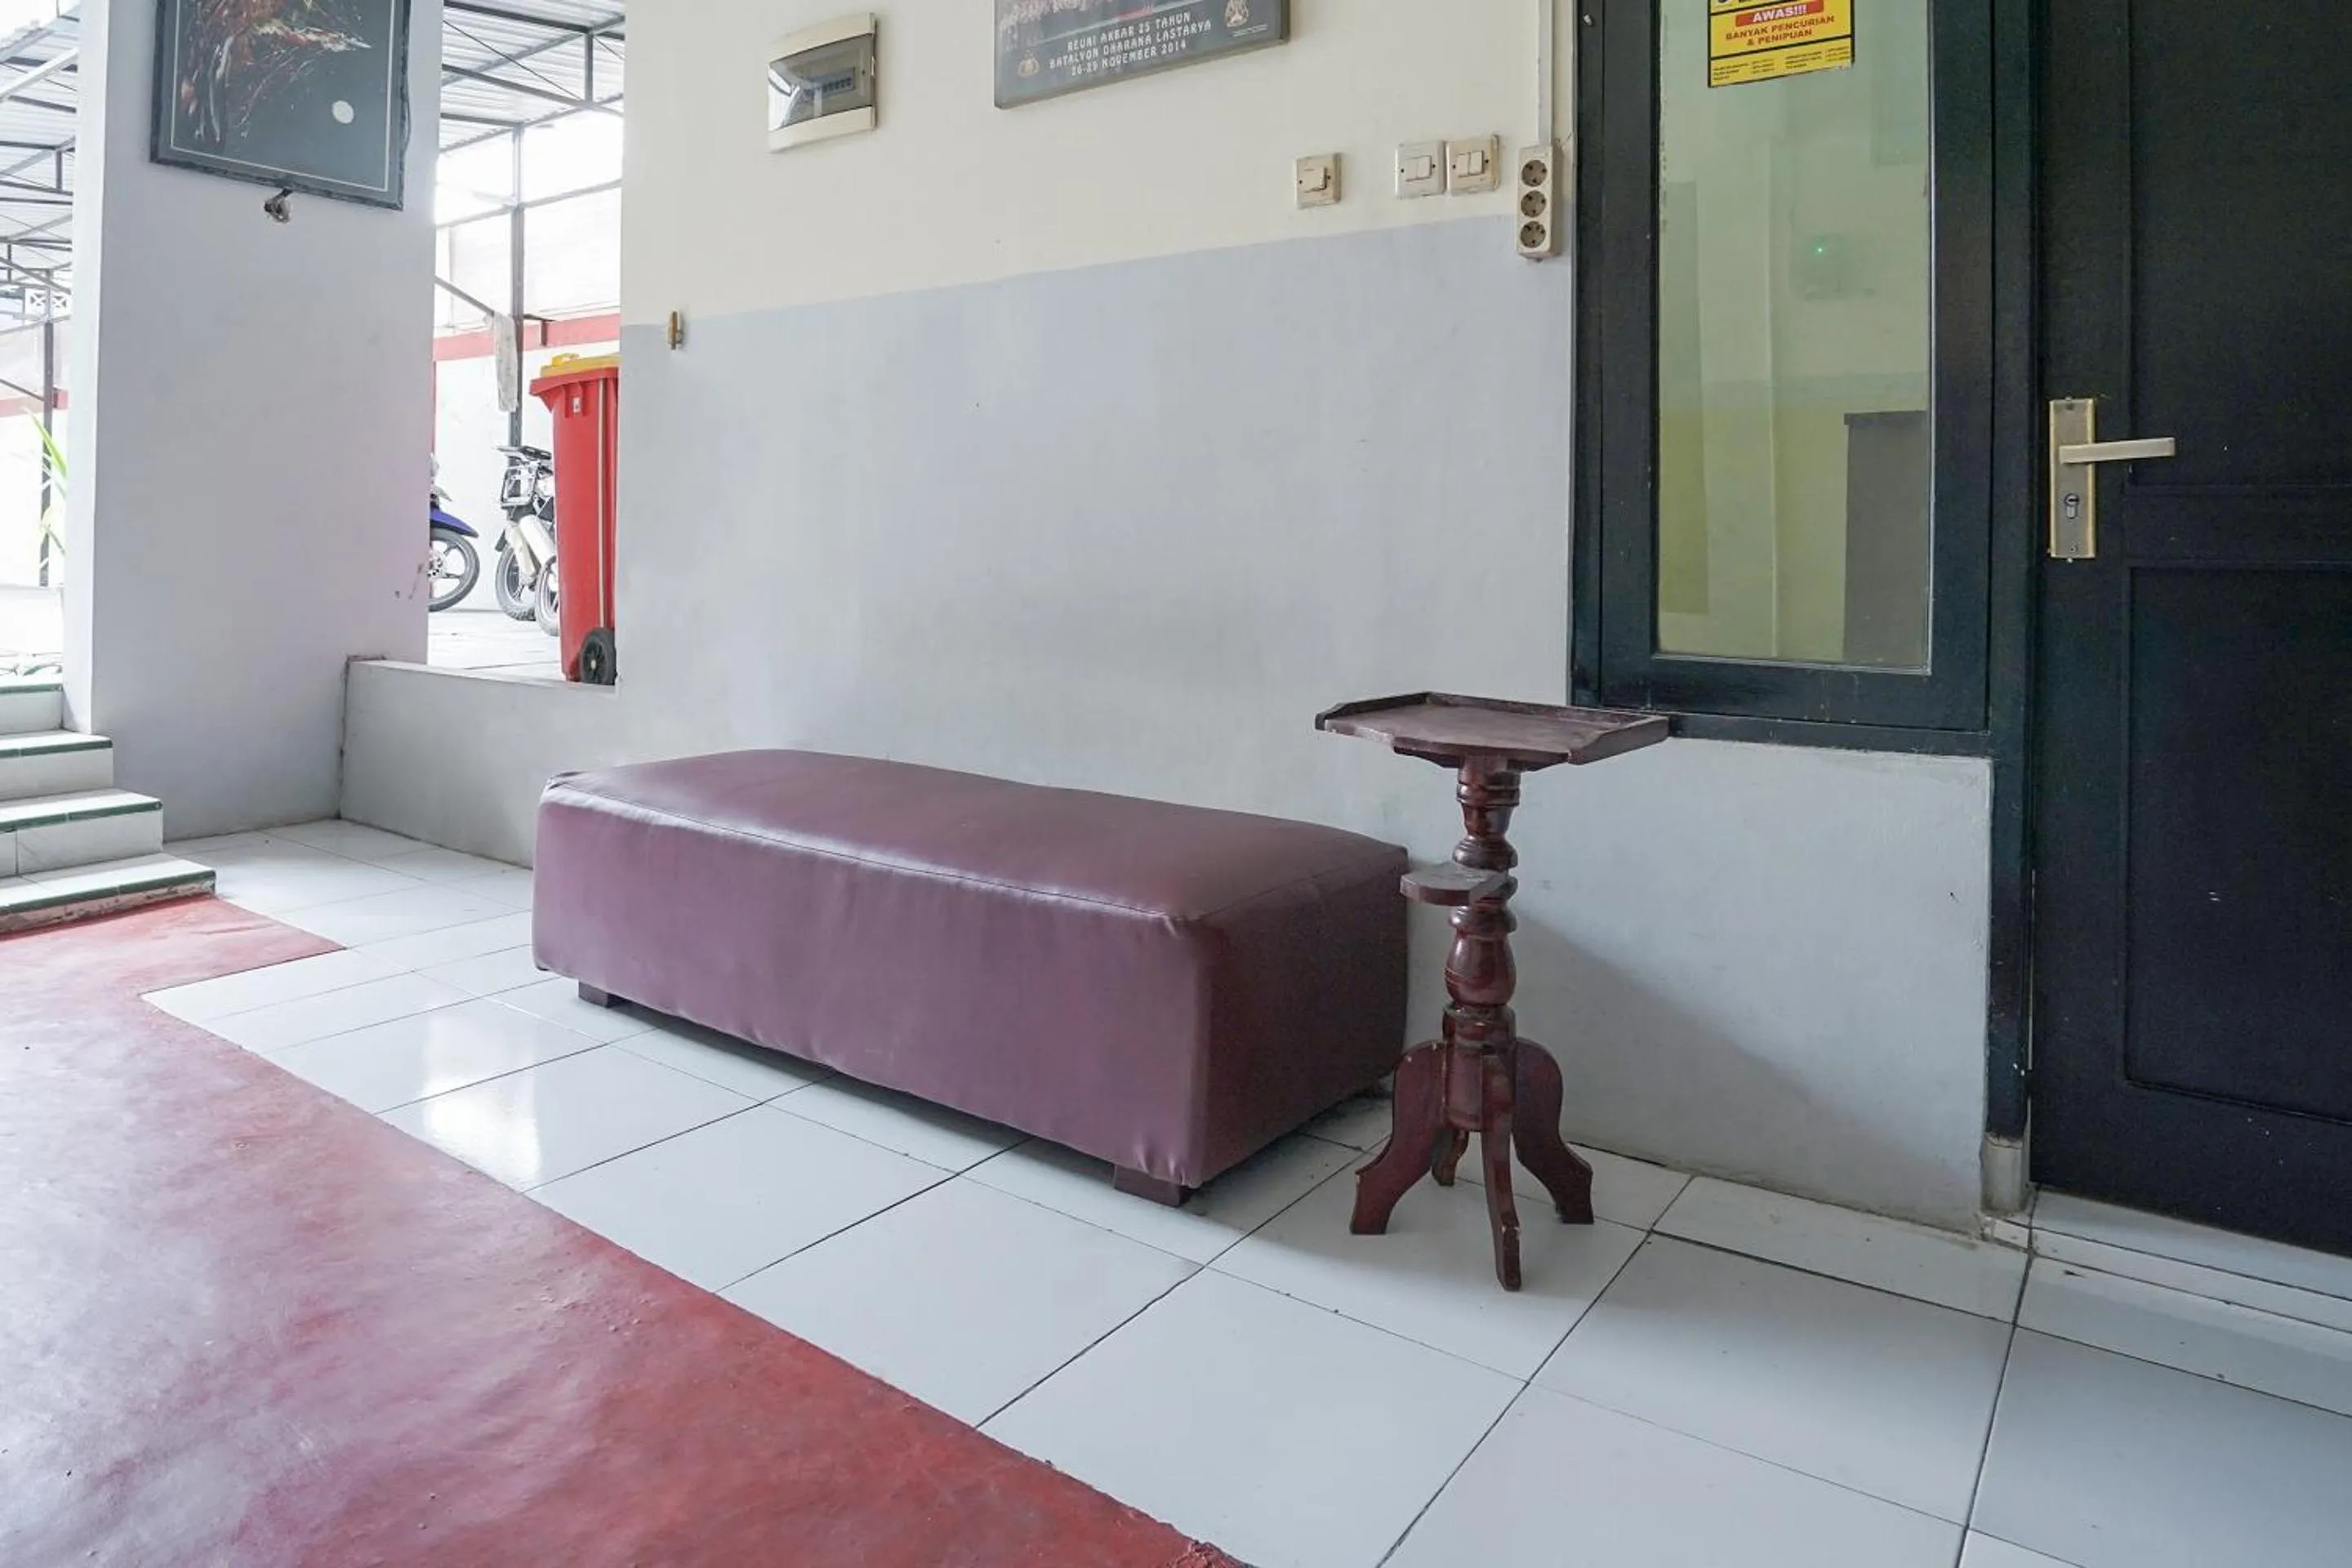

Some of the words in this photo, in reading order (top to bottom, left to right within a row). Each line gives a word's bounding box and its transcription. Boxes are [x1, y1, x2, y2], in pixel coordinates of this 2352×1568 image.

[1752, 4, 1807, 23] AWAS!!!
[1067, 35, 1098, 51] REUNI
[1100, 25, 1134, 42] AKBAR
[1138, 21, 1151, 34] 25
[1156, 11, 1191, 29] TAHUN
[1725, 26, 1769, 40] BANYAK
[1771, 16, 1835, 33] PENCURIAN
[1745, 38, 1755, 47] &
[1757, 29, 1813, 45] PENIPUAN
[1049, 47, 1099, 69] BATALYON
[1156, 20, 1212, 42] LASTARYA
[1102, 46, 1157, 69] NOVEMBER
[1160, 41, 1187, 55] 2014
